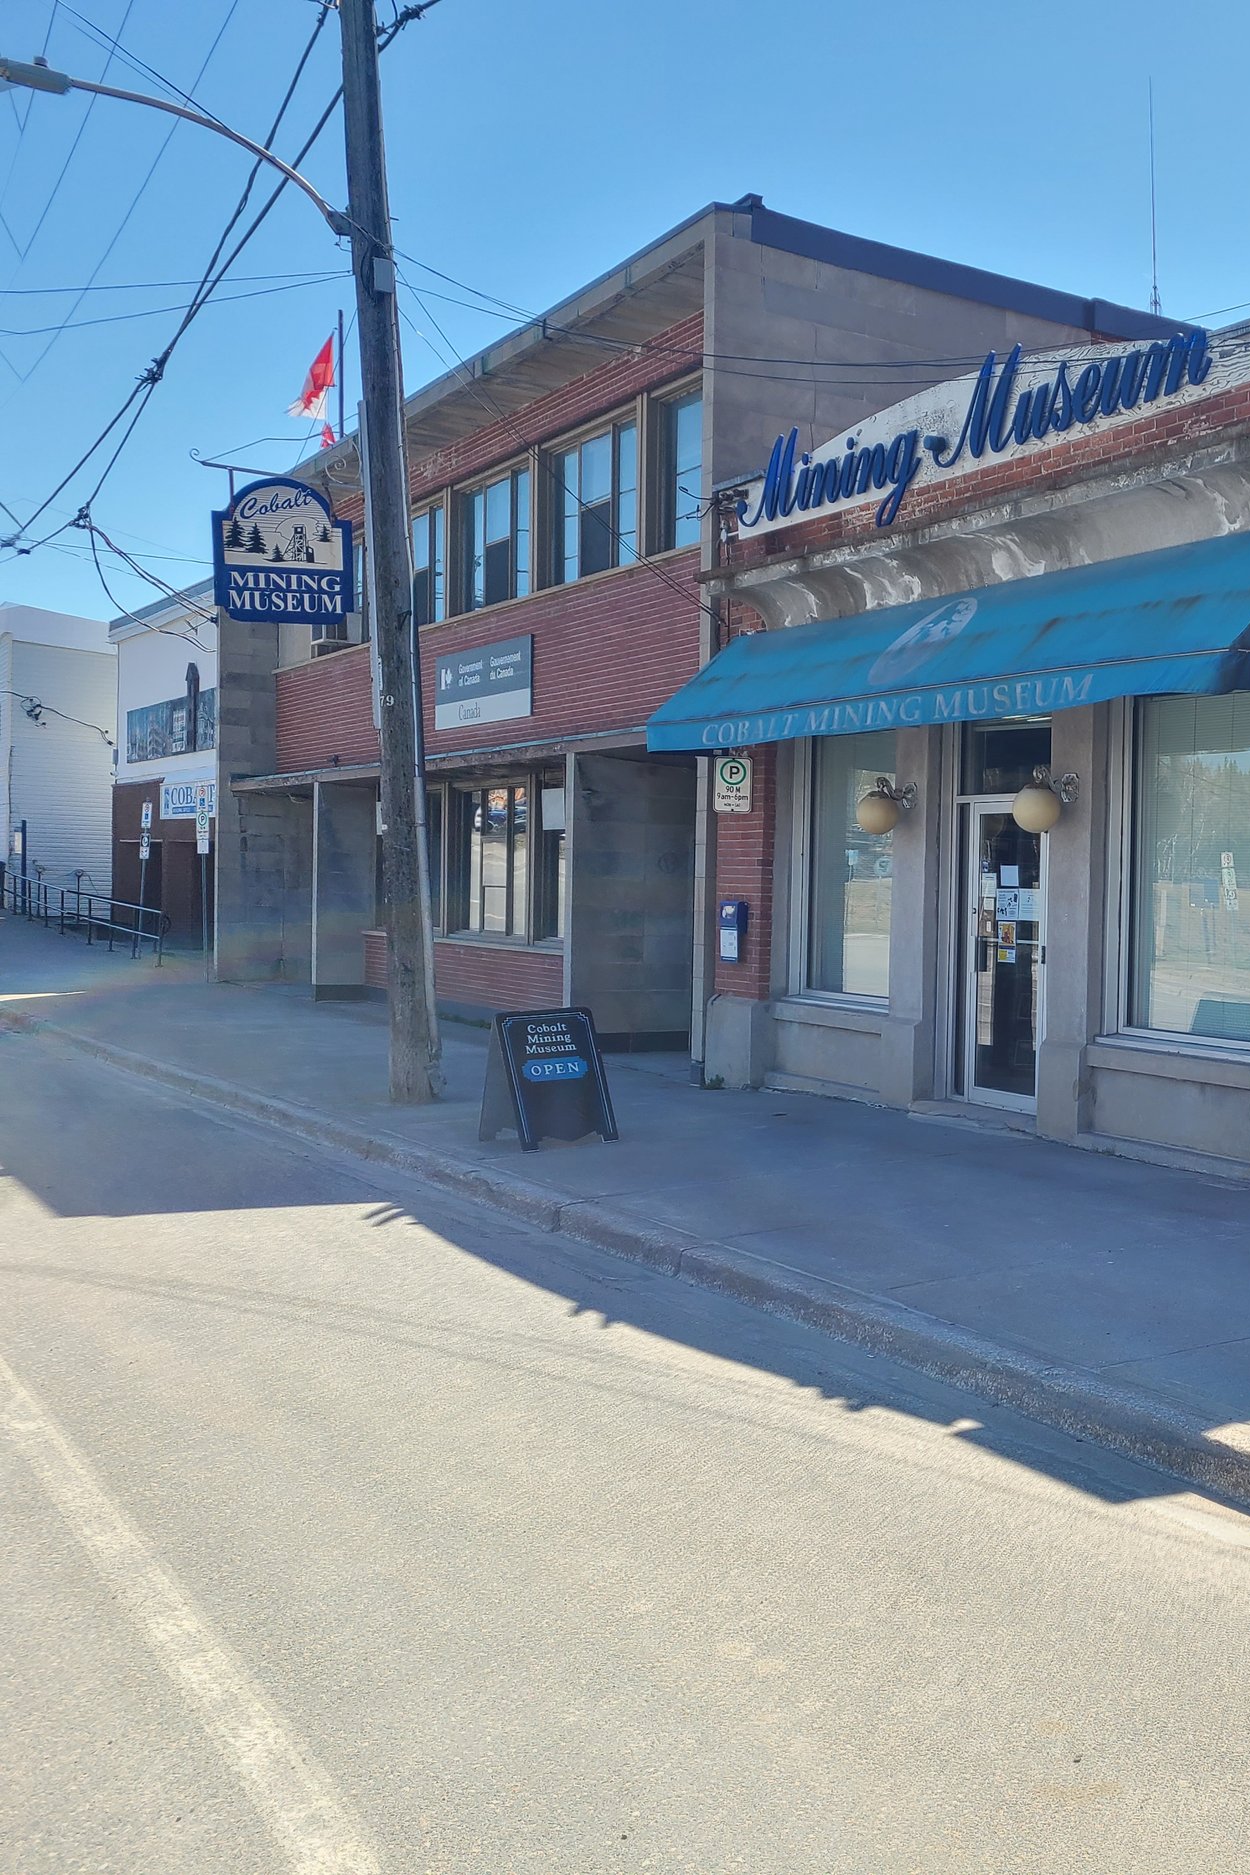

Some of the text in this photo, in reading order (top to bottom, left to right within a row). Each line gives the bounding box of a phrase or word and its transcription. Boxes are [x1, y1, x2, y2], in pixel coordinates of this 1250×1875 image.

[737, 328, 1214, 528] Mining Museum
[239, 488, 312, 520] Cobalt
[229, 571, 343, 592] MINING
[228, 589, 344, 614] MUSEUM
[458, 659, 483, 674] Government
[496, 665, 514, 679] Canada
[463, 673, 481, 686] Canada
[458, 702, 481, 721] Canada
[701, 673, 1095, 746] COBALT MINING MUSEUM
[729, 766, 740, 779] P
[171, 784, 215, 806] COBT
[725, 785, 735, 793] 90
[717, 793, 748, 801] 9am-6pm
[527, 1023, 568, 1034] Cobalt
[526, 1033, 572, 1045] Mining
[525, 1043, 577, 1055] Museum
[531, 1062, 580, 1076] OPEN
